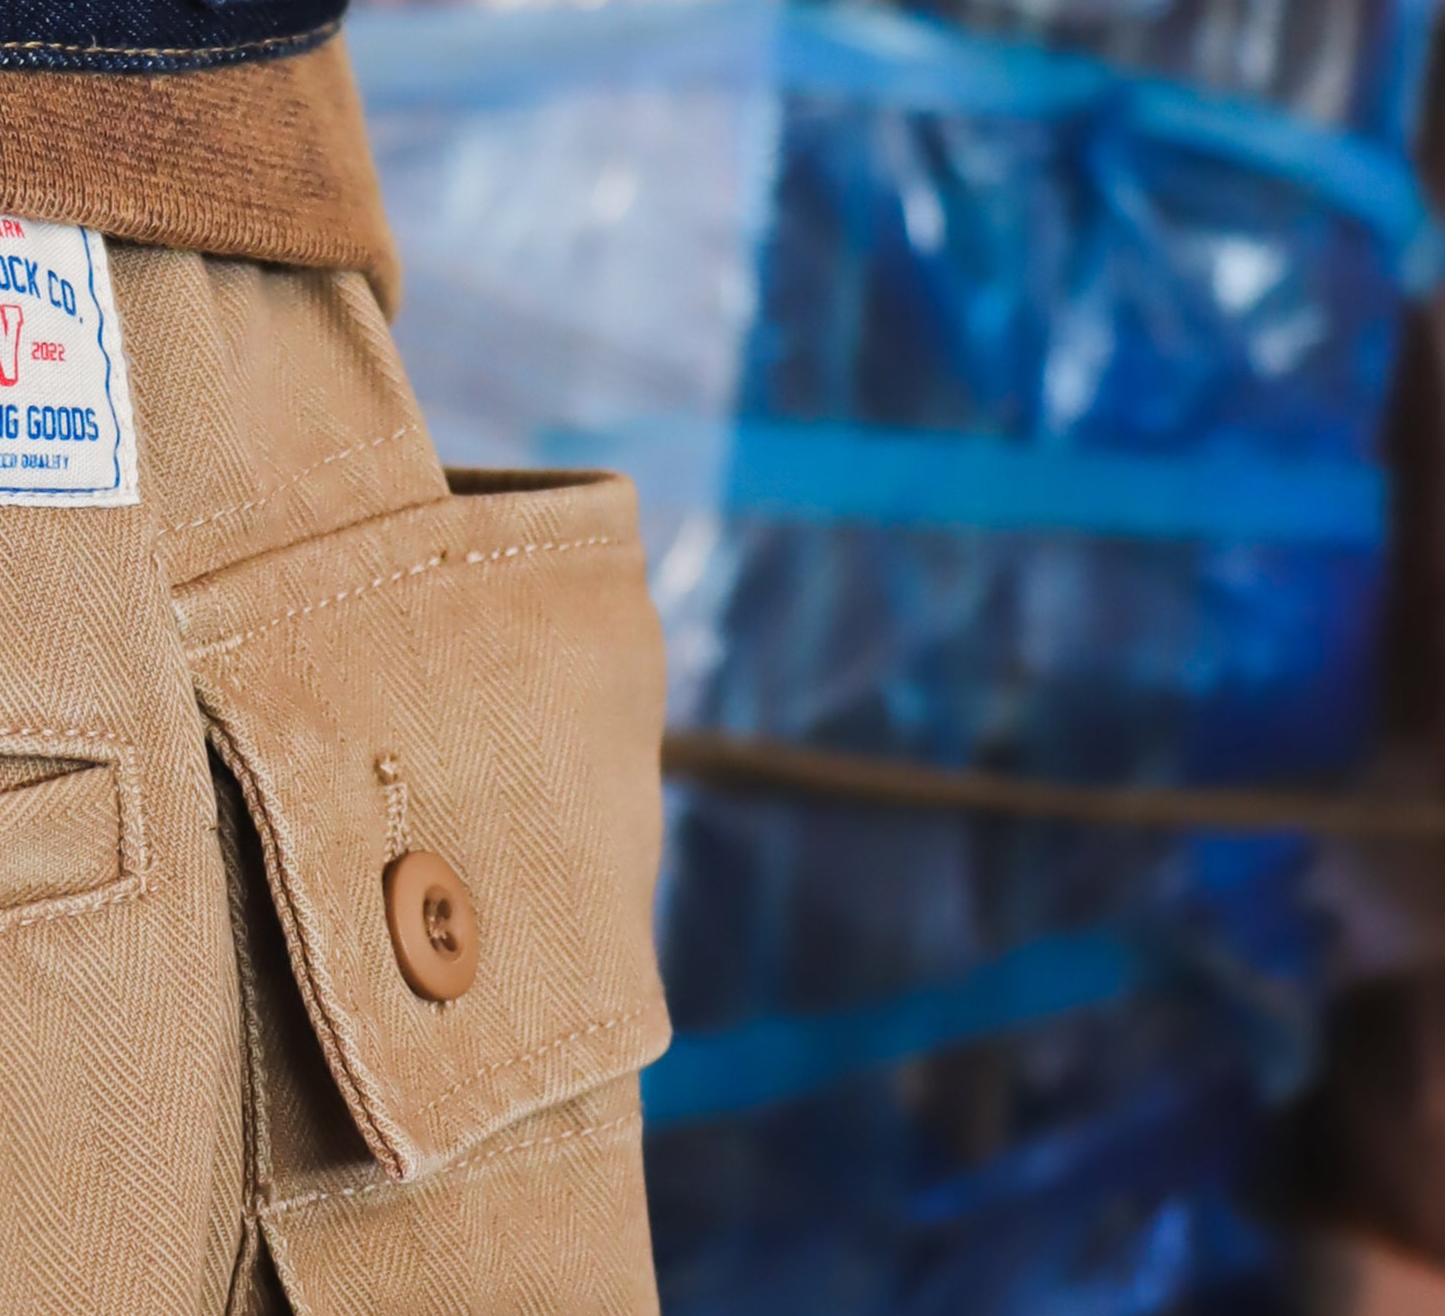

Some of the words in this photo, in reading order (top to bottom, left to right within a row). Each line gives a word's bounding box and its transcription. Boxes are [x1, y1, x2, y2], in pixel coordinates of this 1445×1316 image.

[31, 341, 66, 362] 2022
[26, 405, 99, 441] GOODS
[21, 453, 69, 471] QUALITY
